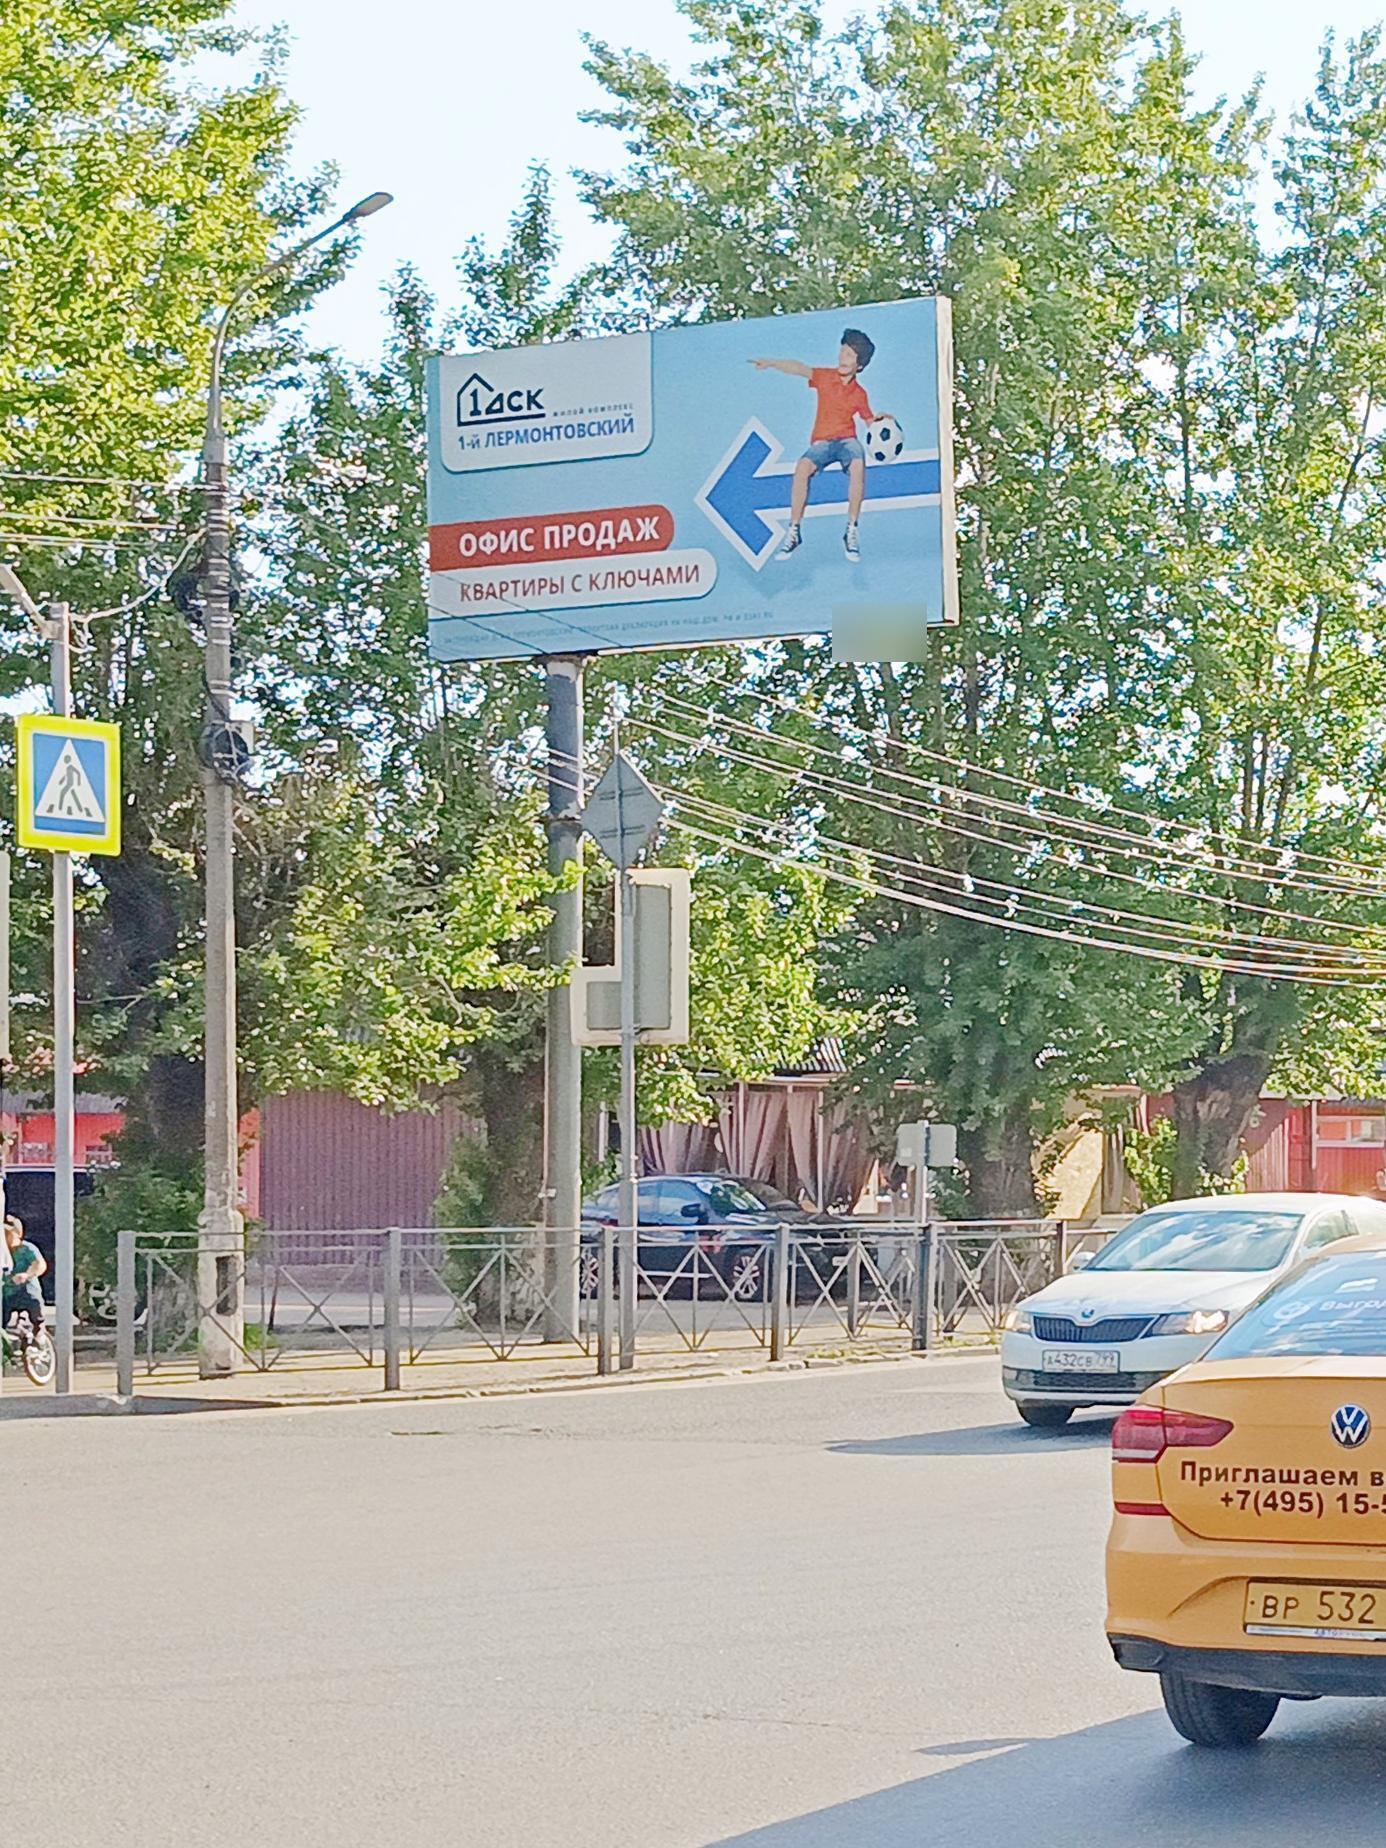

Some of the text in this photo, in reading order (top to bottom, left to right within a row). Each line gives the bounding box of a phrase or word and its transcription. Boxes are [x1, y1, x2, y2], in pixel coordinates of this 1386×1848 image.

[485, 412, 635, 448] ЛЕРМОНТОВСКИЙ
[459, 515, 660, 557] ОФИС ПРОДАЖ
[460, 564, 700, 602] КВАРТИРЫ С КЛЮЧАМИ
[1181, 1460, 1358, 1487] Приглашаем
[1220, 1490, 1324, 1519] +7(495)
[1261, 1594, 1300, 1619] ВР
[1316, 1590, 1377, 1624] 532
